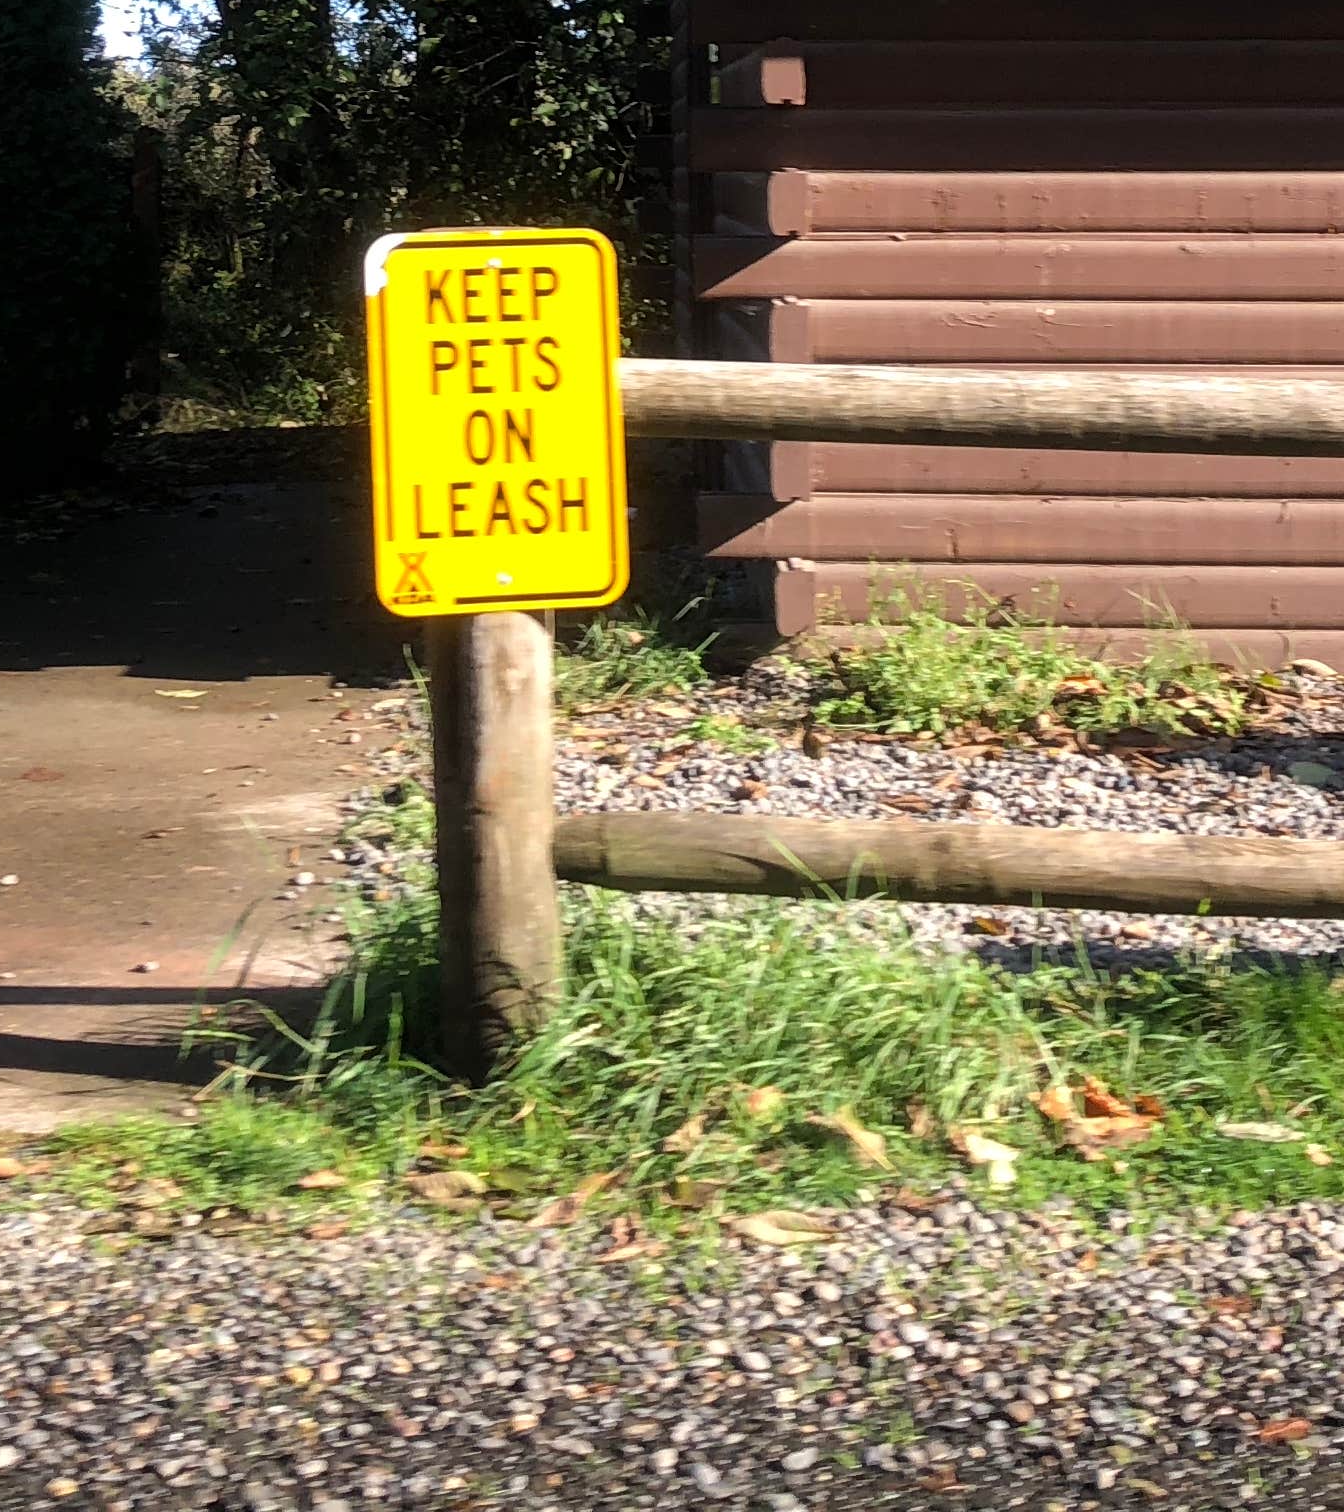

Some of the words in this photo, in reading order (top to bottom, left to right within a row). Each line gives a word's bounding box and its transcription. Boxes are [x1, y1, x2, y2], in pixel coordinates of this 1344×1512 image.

[424, 266, 560, 324] KEEP
[430, 336, 561, 395] PETS
[465, 408, 536, 466] ON
[414, 477, 588, 539] LEASH
